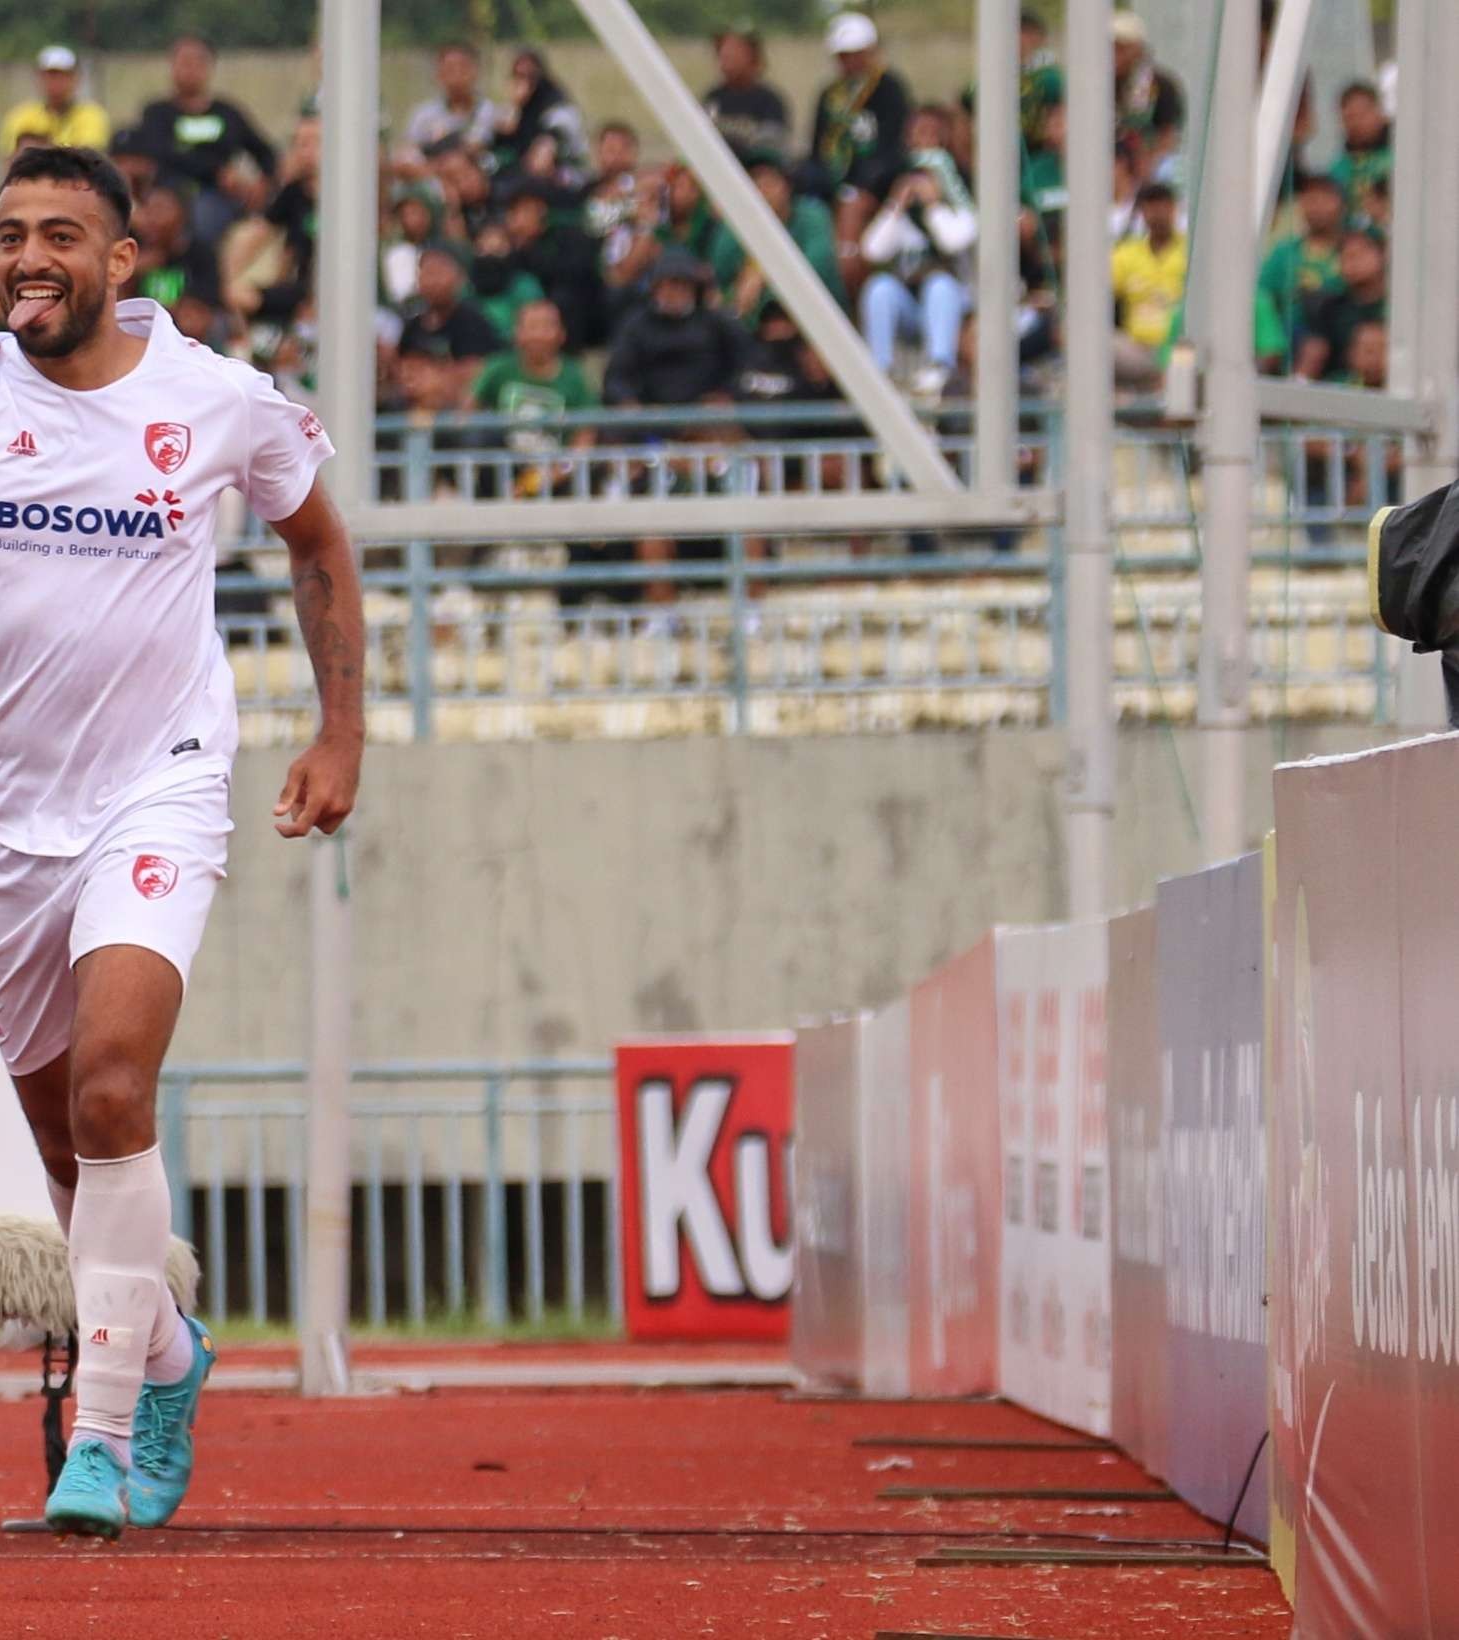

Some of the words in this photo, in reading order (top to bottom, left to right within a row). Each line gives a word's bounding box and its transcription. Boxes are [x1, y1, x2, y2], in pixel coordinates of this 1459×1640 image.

[55, 546, 64, 555] a
[69, 543, 112, 558] Better
[117, 546, 162, 560] Future
[637, 1075, 794, 1302] Ku
[1351, 1090, 1409, 1358] Jelas
